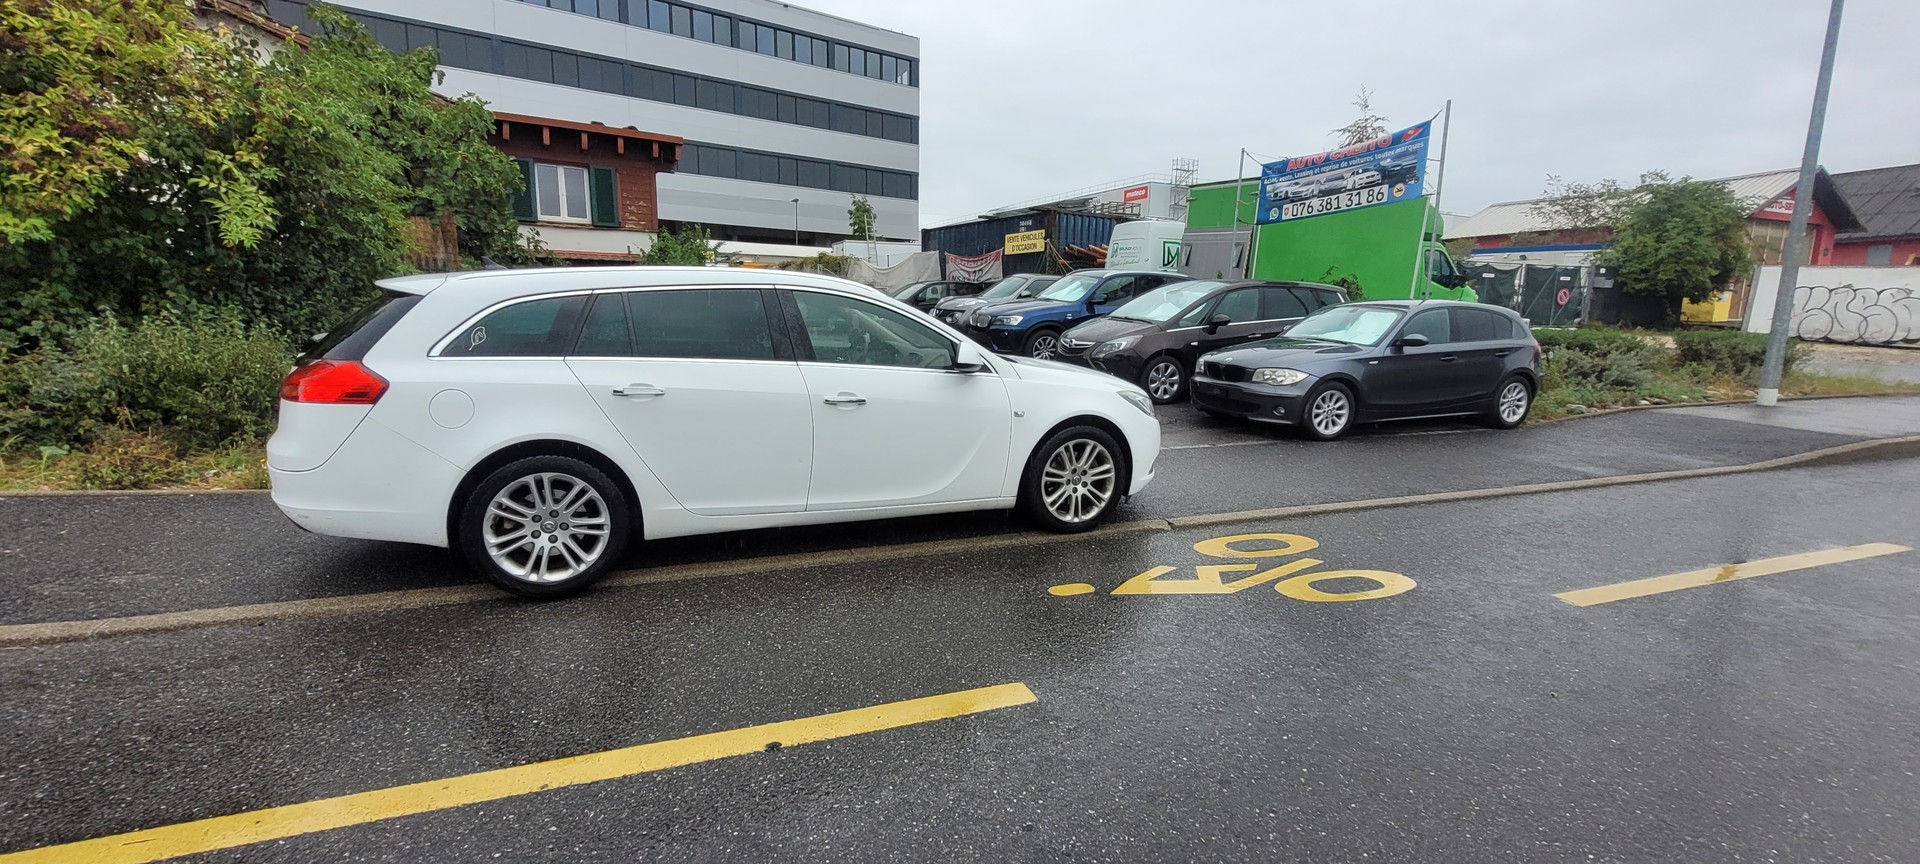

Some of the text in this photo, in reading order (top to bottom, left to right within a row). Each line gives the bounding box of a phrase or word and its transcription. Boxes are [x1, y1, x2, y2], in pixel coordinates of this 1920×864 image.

[1286, 152, 1327, 171] AUTO
[1294, 169, 1314, 179] Leasing
[1320, 163, 1340, 173] reprise
[1349, 155, 1374, 165] voitures
[1374, 150, 1395, 160] toutes
[1395, 142, 1424, 154] marques
[1291, 187, 1385, 217] 076 381 31 86
[1006, 232, 1044, 243] VENTE VEHICULES
[1012, 243, 1038, 252] D'OCCASION
